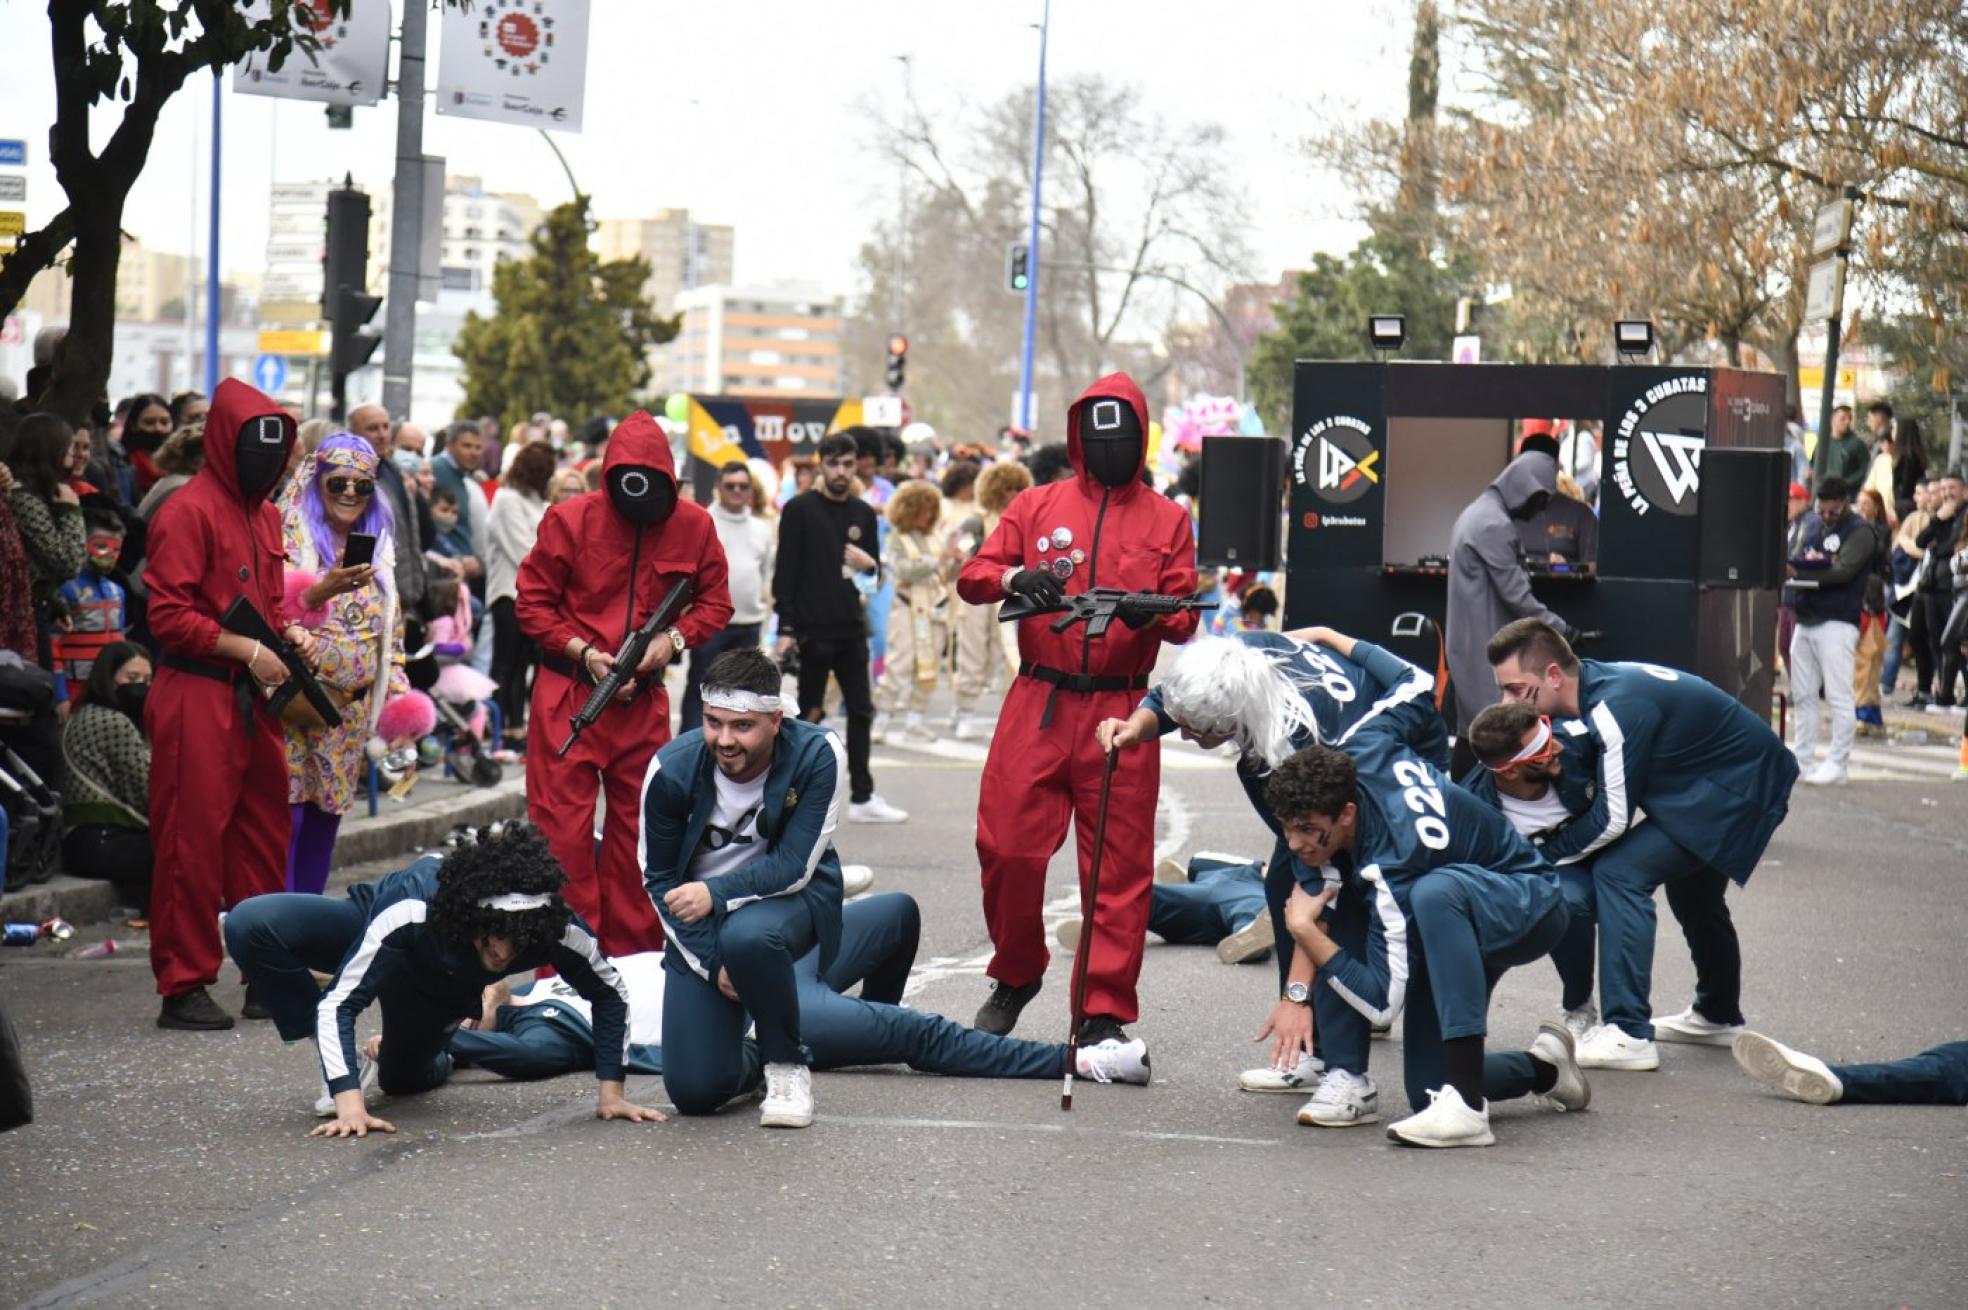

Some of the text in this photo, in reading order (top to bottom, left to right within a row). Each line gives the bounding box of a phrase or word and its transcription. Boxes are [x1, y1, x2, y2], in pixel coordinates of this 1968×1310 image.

[1612, 376, 1708, 516] LA PEÑA DE LOS 3 CUBATAS
[1393, 759, 1450, 851] 022
